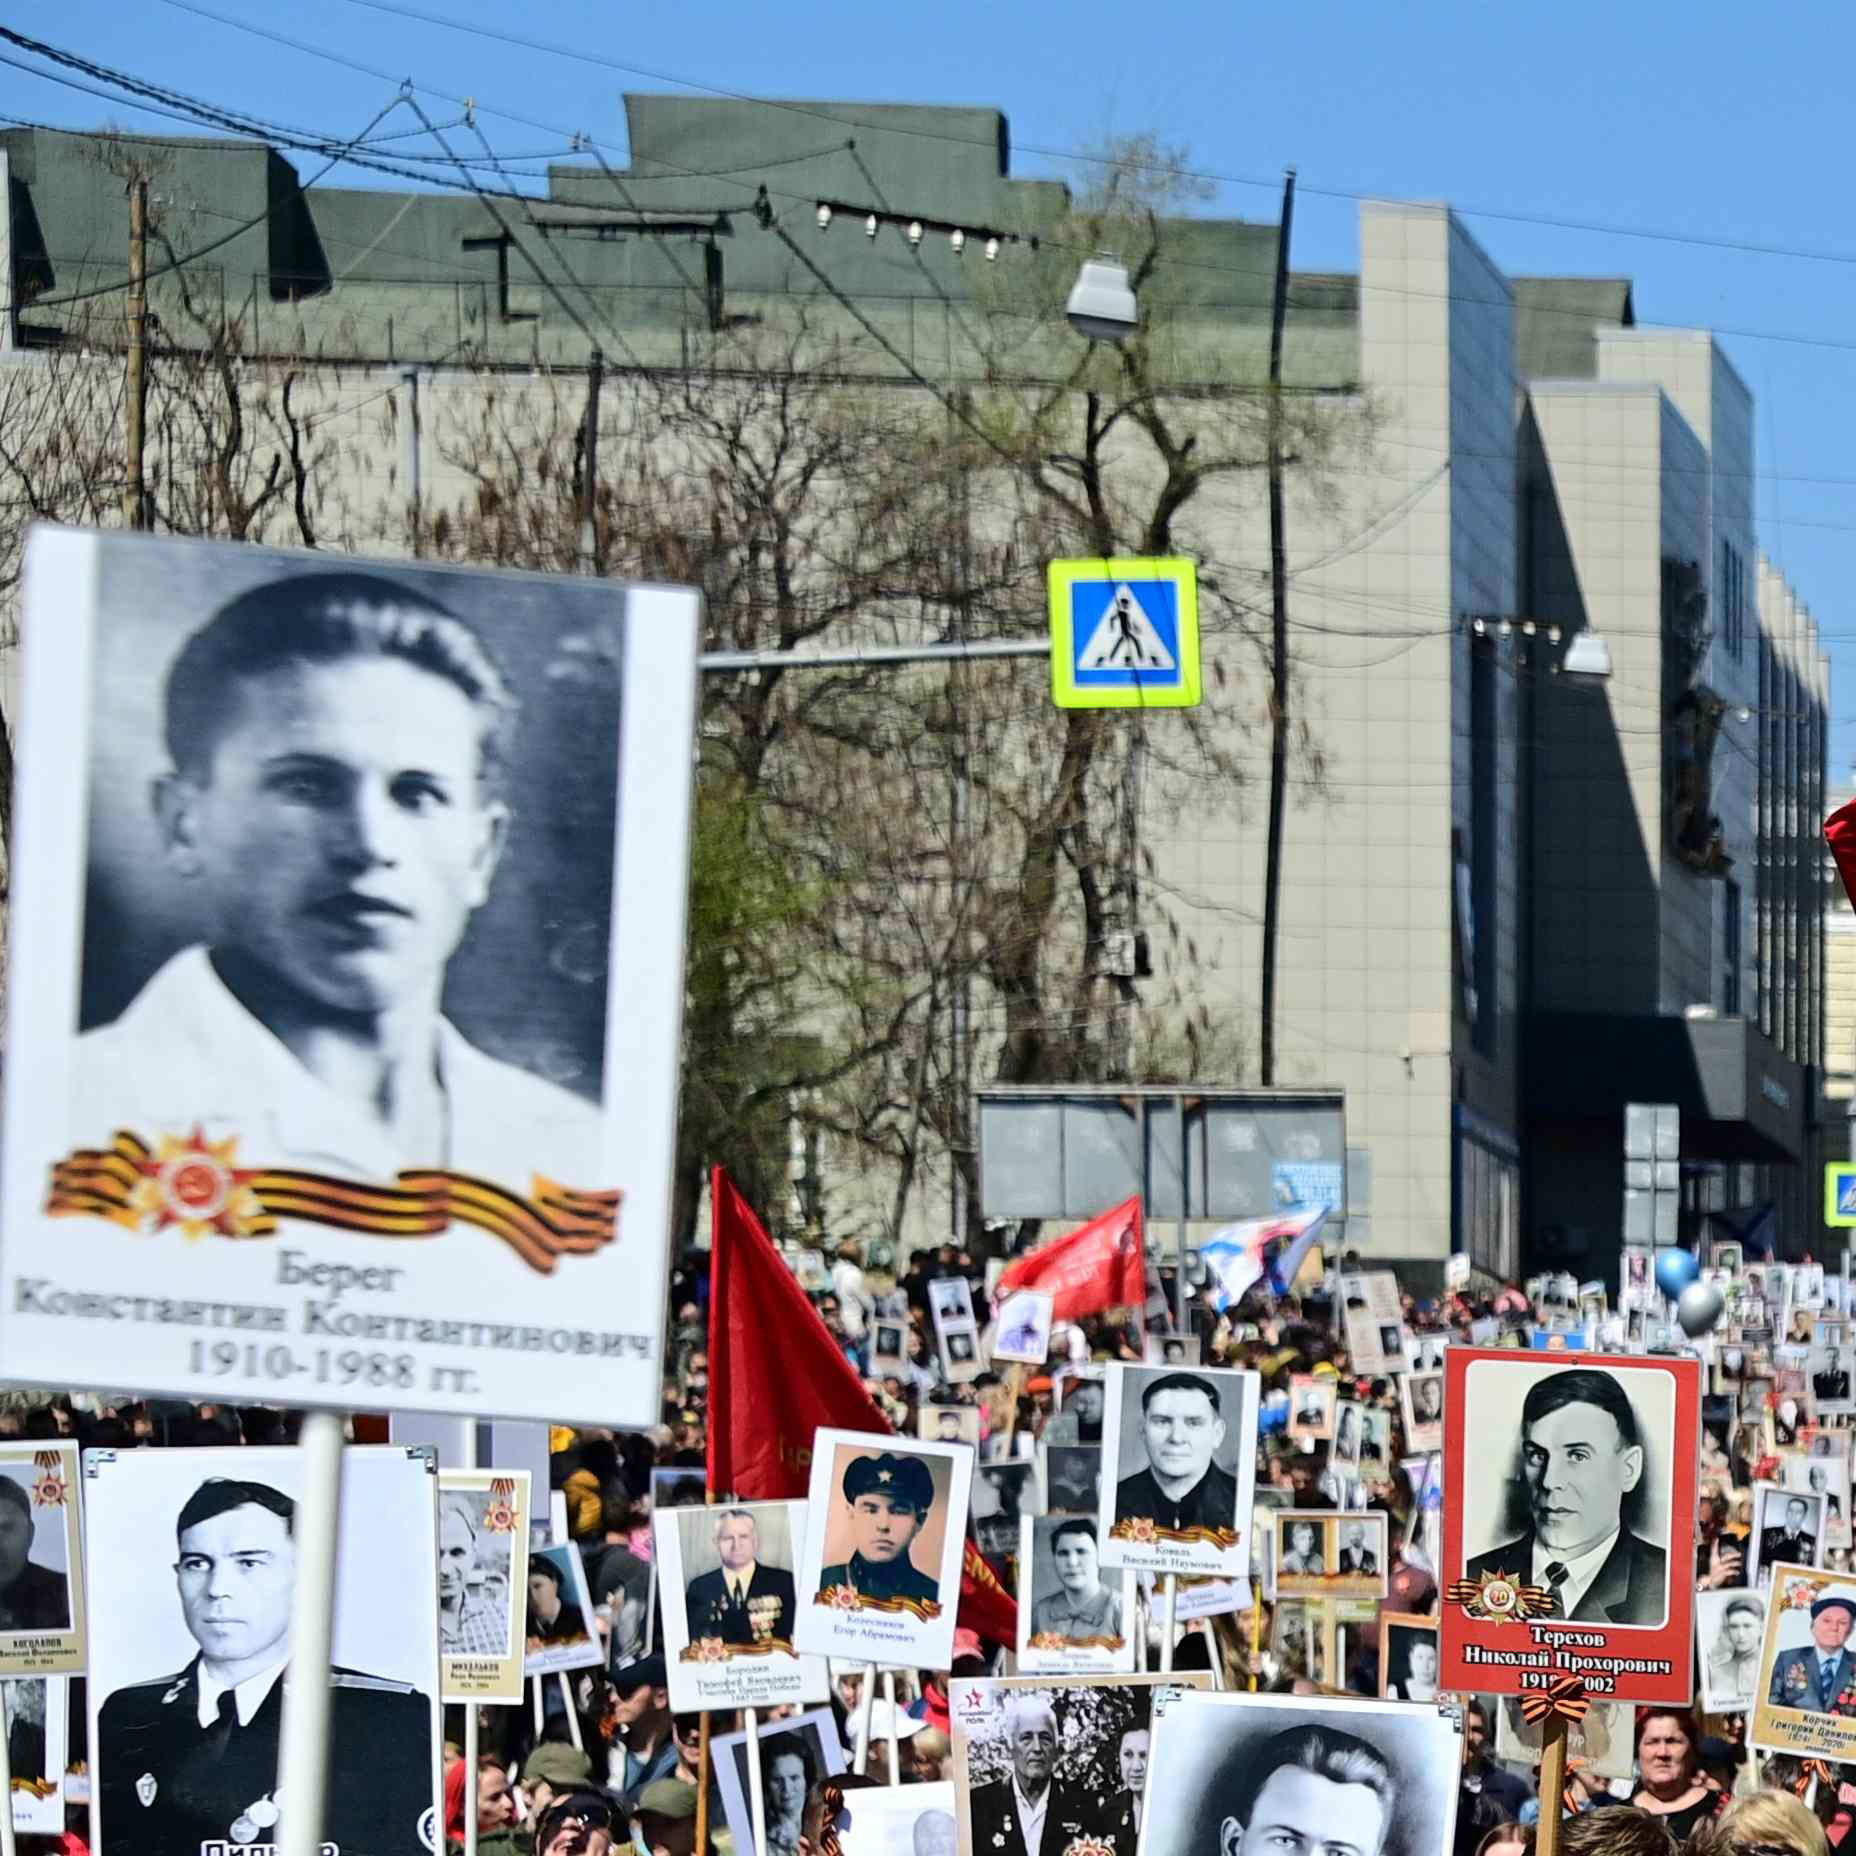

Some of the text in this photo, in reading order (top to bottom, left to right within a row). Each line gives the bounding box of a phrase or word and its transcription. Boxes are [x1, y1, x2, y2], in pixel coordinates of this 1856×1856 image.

[277, 1250, 402, 1296] Берег
[15, 1277, 655, 1360] Константин Контантинович
[188, 1340, 483, 1396] 1910-1988 гг.
[1465, 1645, 1673, 1675] Николай Прохорович
[1530, 1626, 1606, 1649] Терехов
